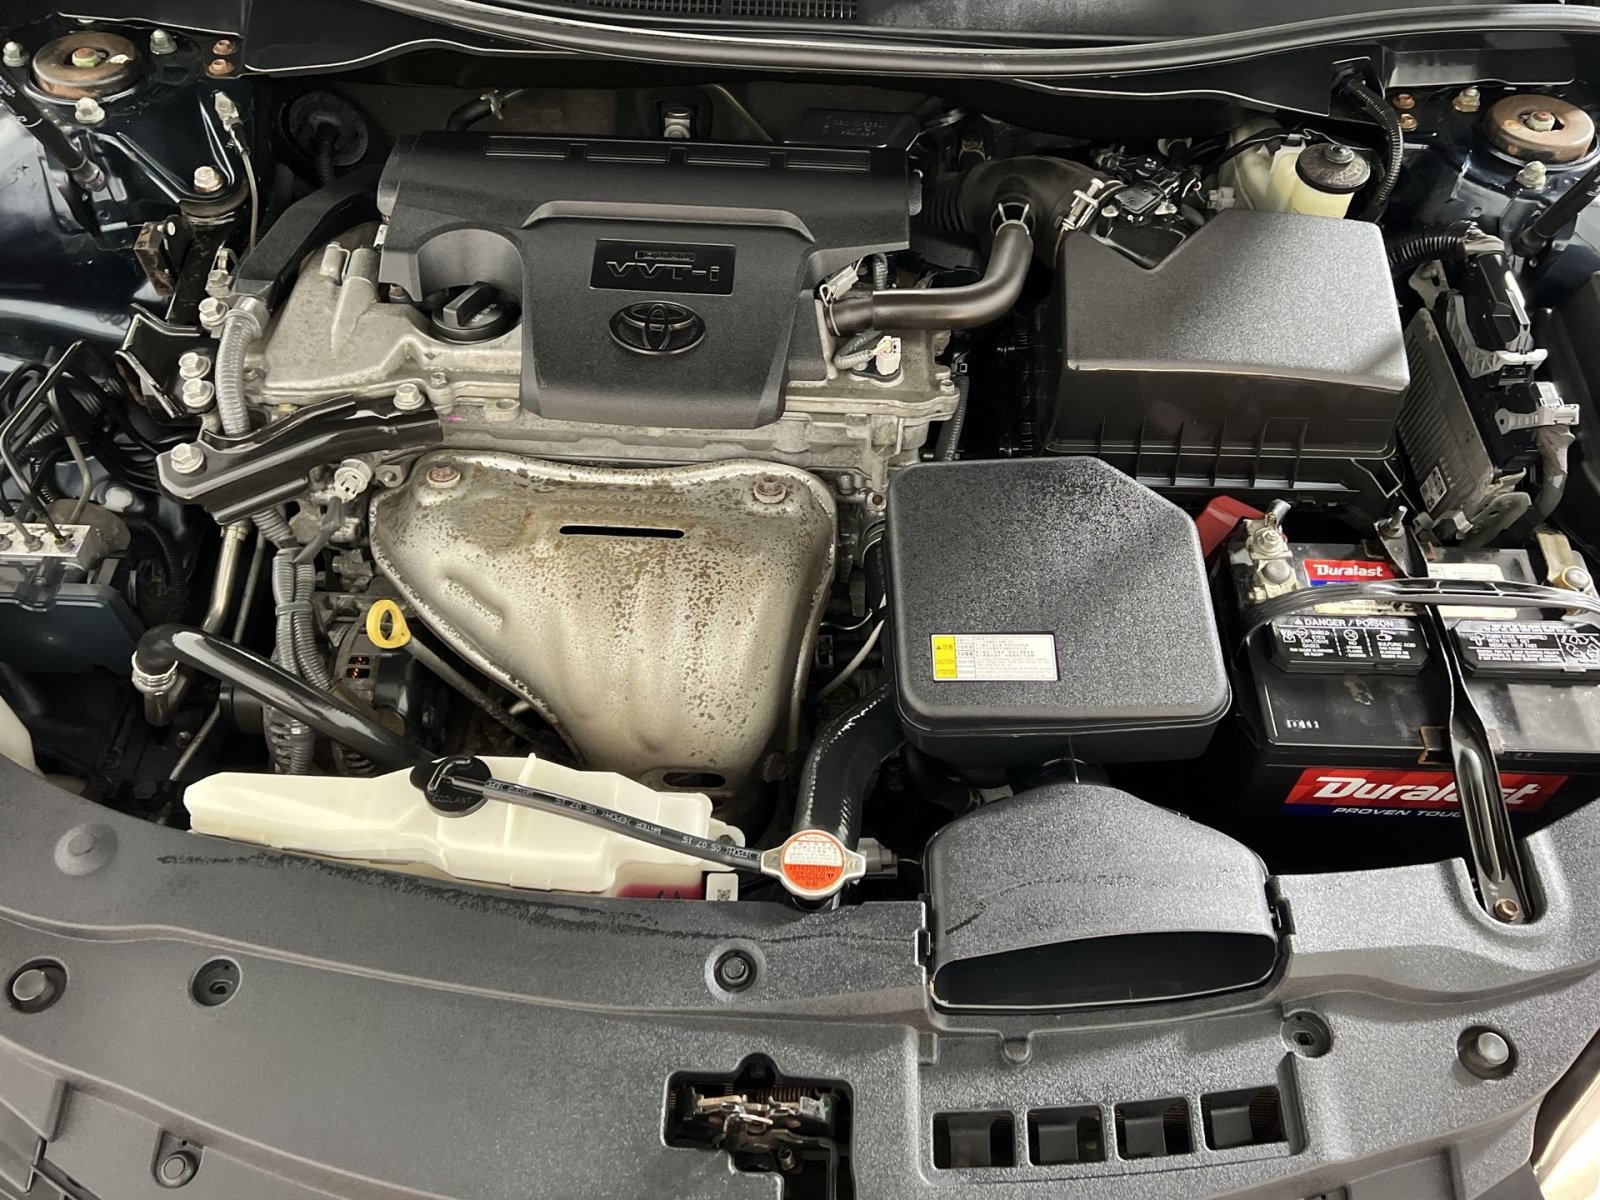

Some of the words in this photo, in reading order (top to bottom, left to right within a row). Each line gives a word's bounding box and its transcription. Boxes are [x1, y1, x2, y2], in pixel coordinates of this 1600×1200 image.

[606, 260, 719, 281] VVT-i
[1313, 563, 1383, 577] Duralast
[1304, 618, 1346, 627] DANGER
[1355, 617, 1394, 628] POISON
[1313, 776, 1541, 804] Duralt
[1332, 807, 1412, 816] PROVEN
[682, 835, 693, 845] 15
[696, 841, 707, 849] 07
